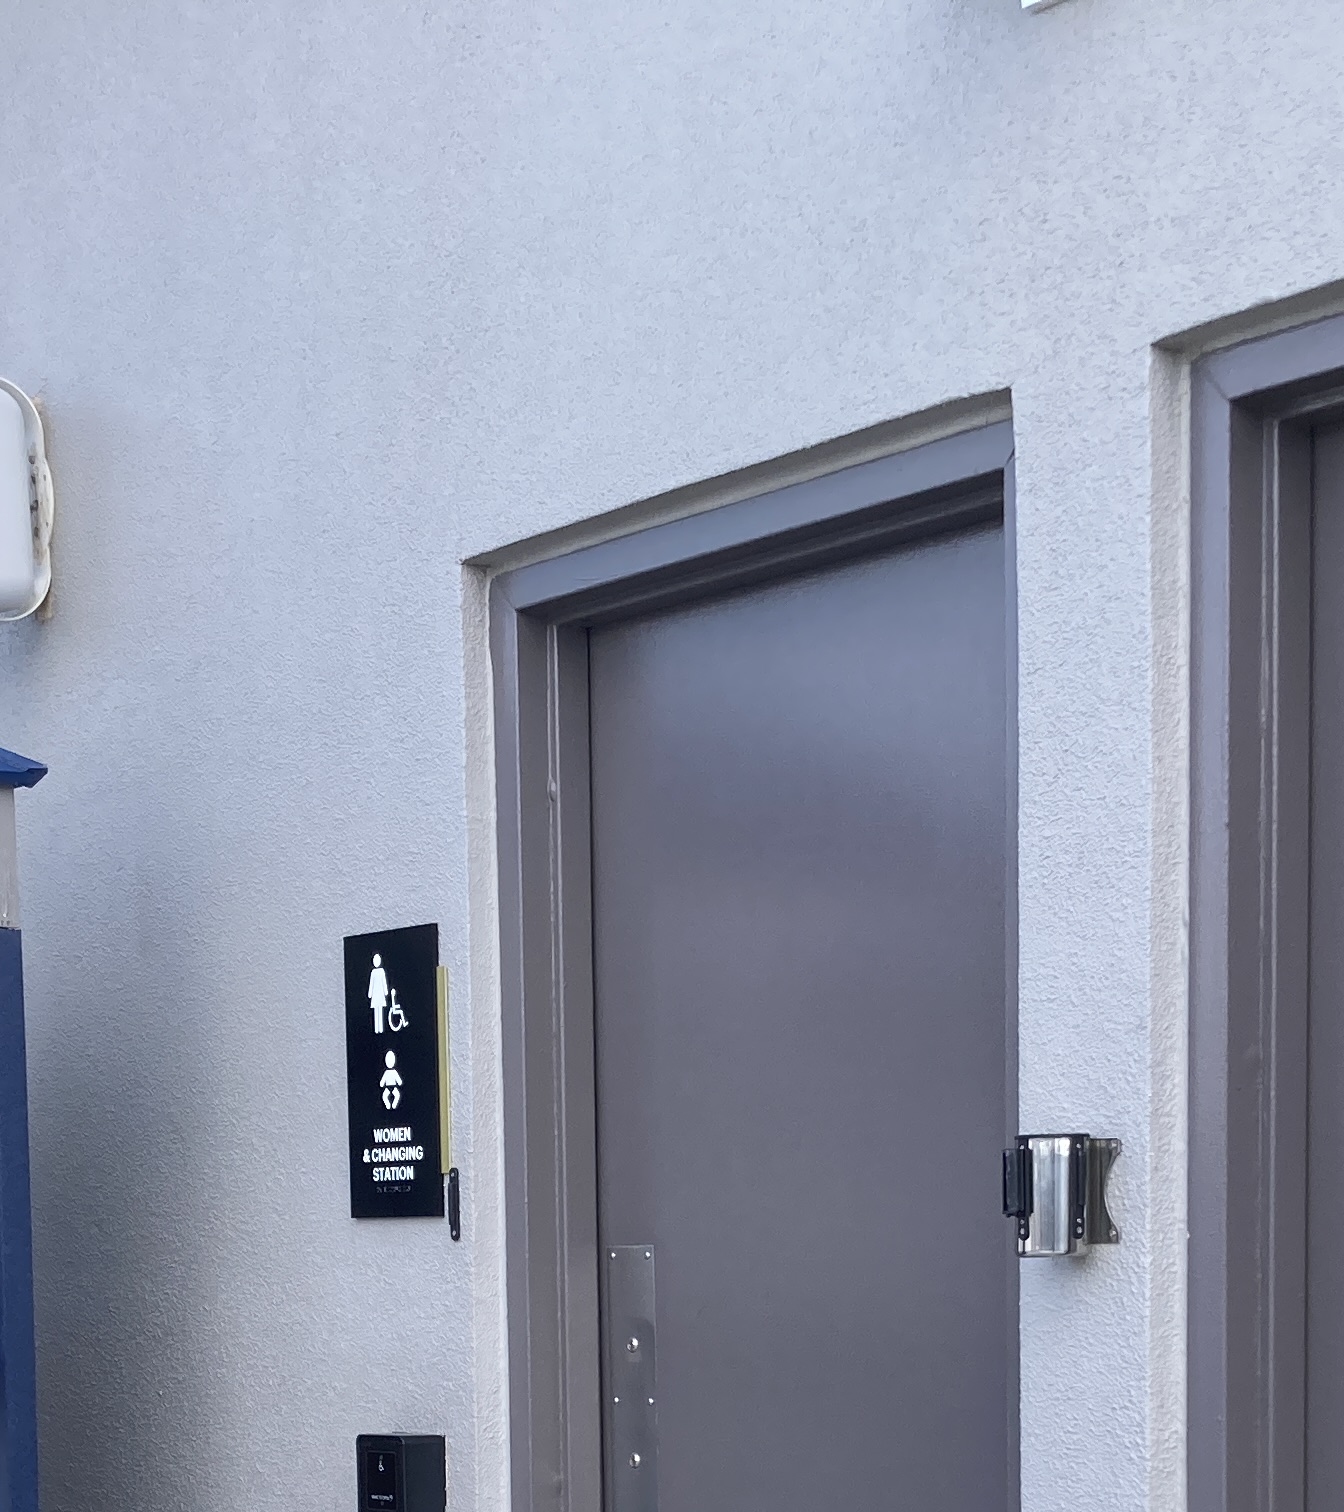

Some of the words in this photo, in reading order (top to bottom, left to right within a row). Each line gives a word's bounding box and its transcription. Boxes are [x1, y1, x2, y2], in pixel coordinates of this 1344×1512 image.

[373, 1127, 411, 1142] WOMEN
[363, 1149, 371, 1163] &
[371, 1146, 423, 1162] CHANGING
[373, 1166, 414, 1181] STATION
